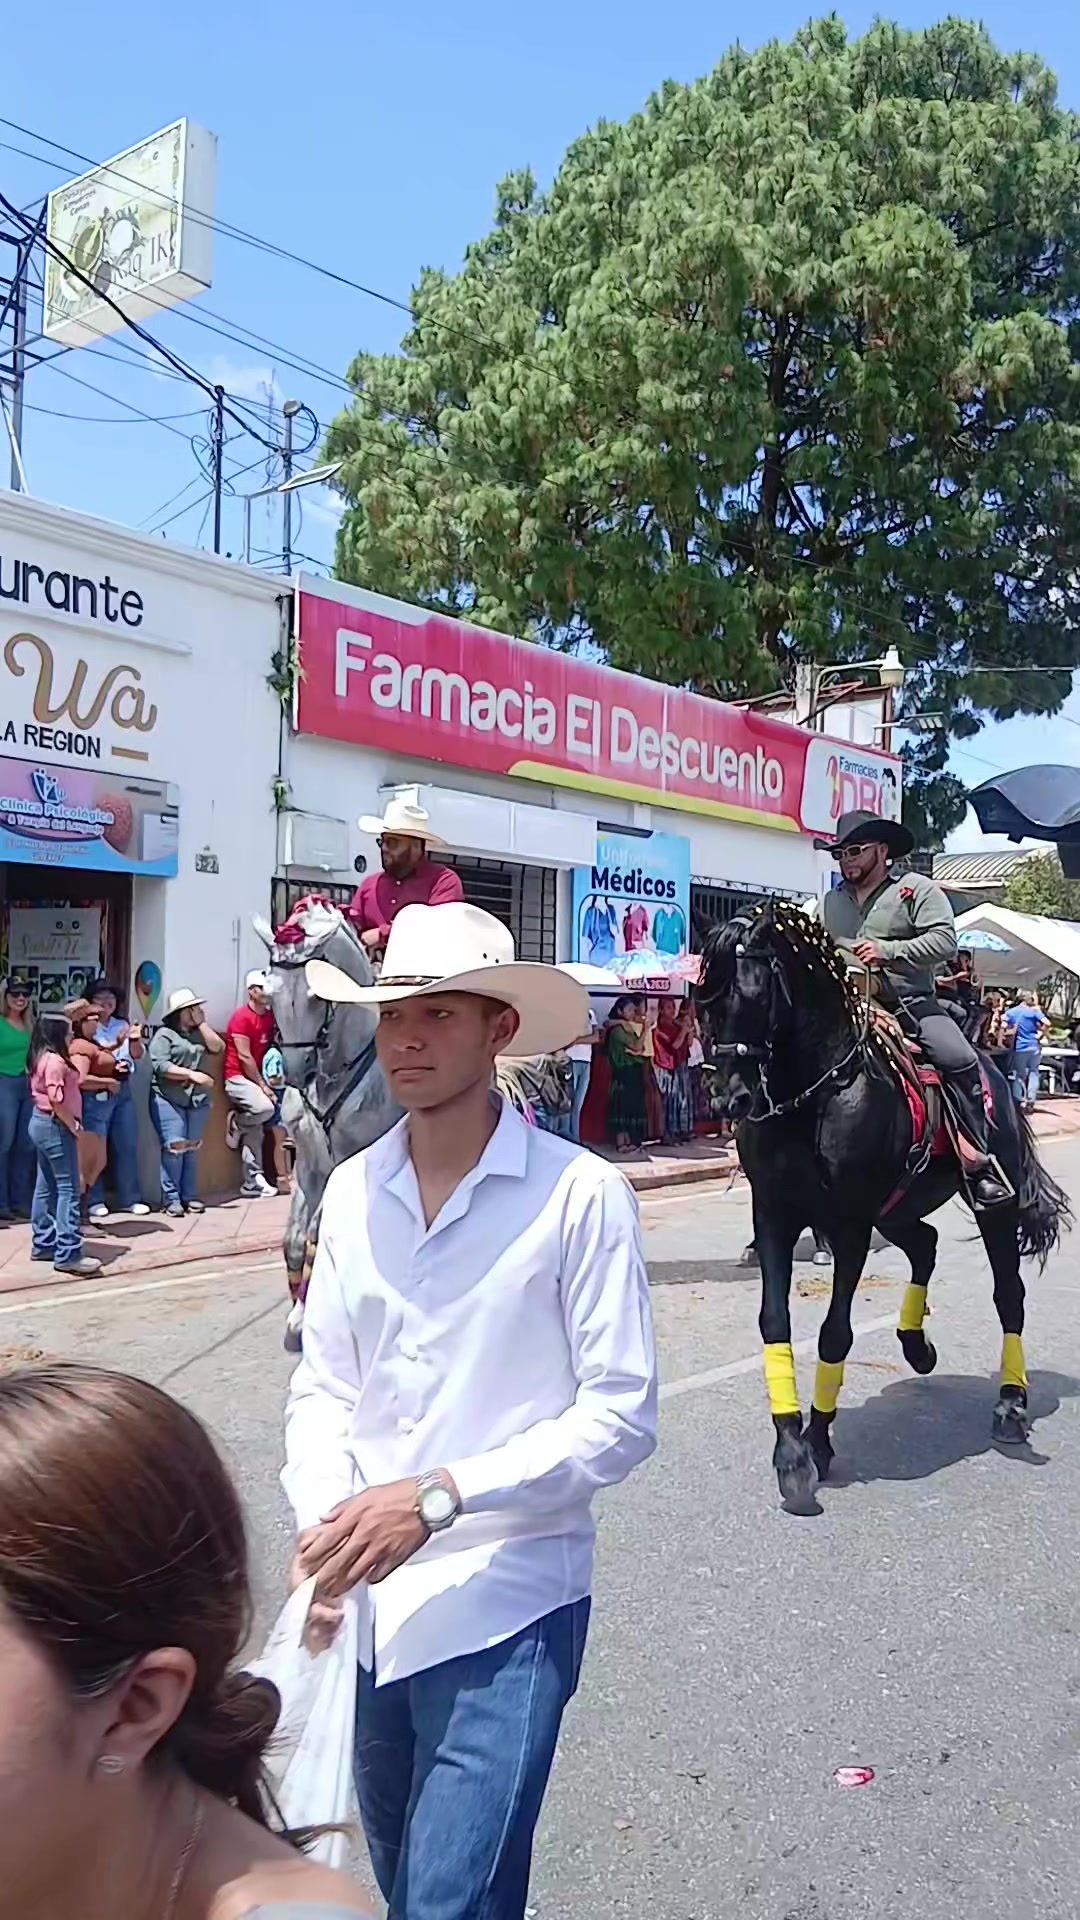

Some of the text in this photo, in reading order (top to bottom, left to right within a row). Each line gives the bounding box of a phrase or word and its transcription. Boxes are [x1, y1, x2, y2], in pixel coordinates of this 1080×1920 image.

[0, 556, 144, 627] urante
[335, 627, 783, 798] Farmacia El Descuento
[0, 720, 101, 759] A REGION
[839, 756, 879, 780] Farmacias
[591, 866, 676, 898] Médicos
